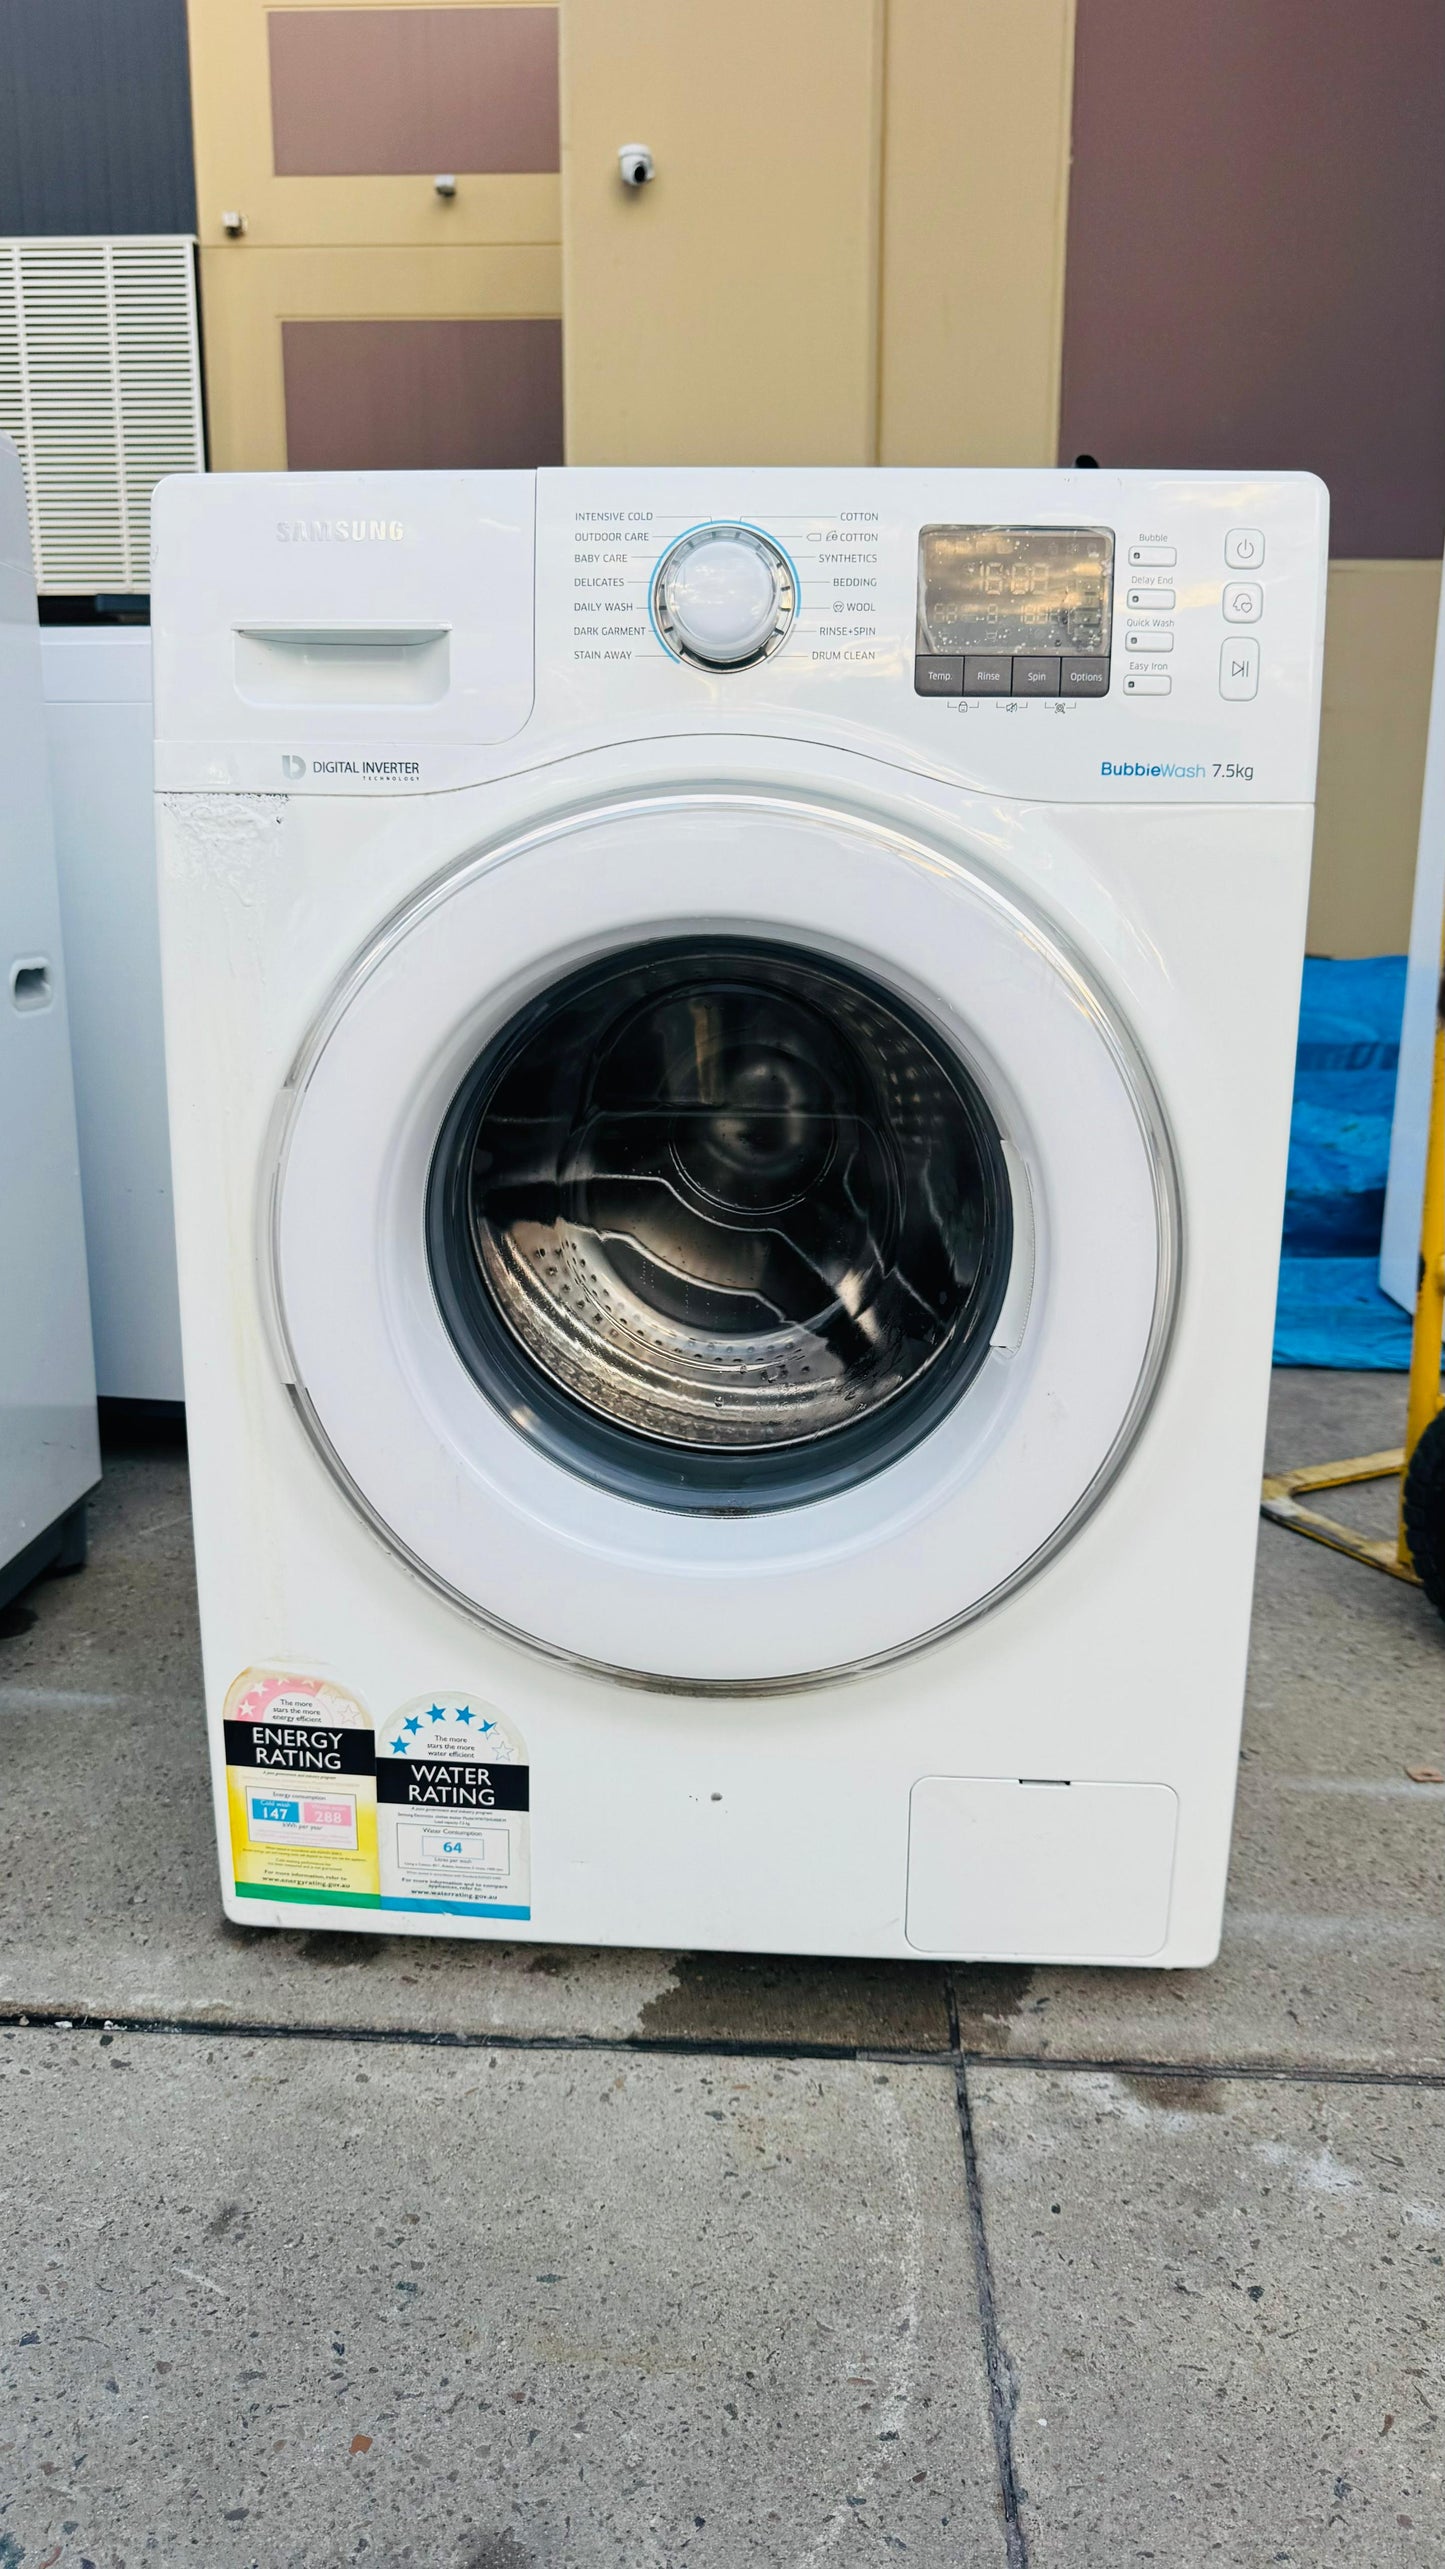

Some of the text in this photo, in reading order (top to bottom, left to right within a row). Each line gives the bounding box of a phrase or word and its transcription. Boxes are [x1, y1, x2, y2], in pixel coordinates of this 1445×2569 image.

[575, 512, 653, 521] INTENSIVE COLD
[840, 512, 879, 521] COTTON
[275, 520, 404, 542] SAMSUNG
[574, 532, 649, 541] OUTDOOR CARE
[839, 533, 878, 541] COTTON
[1139, 533, 1168, 542] Bubble
[574, 554, 628, 563] BABY CARE
[818, 554, 878, 563] SYNTHETICS
[574, 578, 625, 587] DELICATES
[833, 578, 877, 587] BEDDING
[1131, 576, 1173, 586] Delay End
[574, 602, 633, 611] DAILY WASH
[846, 602, 876, 611] WOOL
[1126, 619, 1174, 628] Quick Wash
[573, 627, 646, 636] DARK GARMENT
[819, 627, 876, 636] RINSE+SPIN
[574, 651, 632, 660] STAIN AWAY
[812, 651, 876, 660] DRUM CLEAN
[1129, 662, 1168, 671] Easy Iron
[928, 671, 953, 682] Temp.
[977, 671, 1000, 681] Rinse
[1027, 671, 1046, 682] Spin
[1070, 672, 1102, 682] Options
[313, 761, 419, 774] DIGITAL INVERTER
[1212, 763, 1254, 781] 7.5kg
[280, 1699, 294, 1707] The
[272, 1714, 322, 1723] energy efficient
[252, 1727, 343, 1749] ENERGY
[255, 1747, 342, 1770] RATING
[448, 1751, 475, 1759] efficient
[411, 1764, 492, 1786] WATER
[408, 1784, 495, 1806] RATING
[263, 1807, 288, 1820] 147
[314, 1810, 342, 1824] 288
[443, 1828, 482, 1836] Consumption
[443, 1842, 463, 1854] 64
